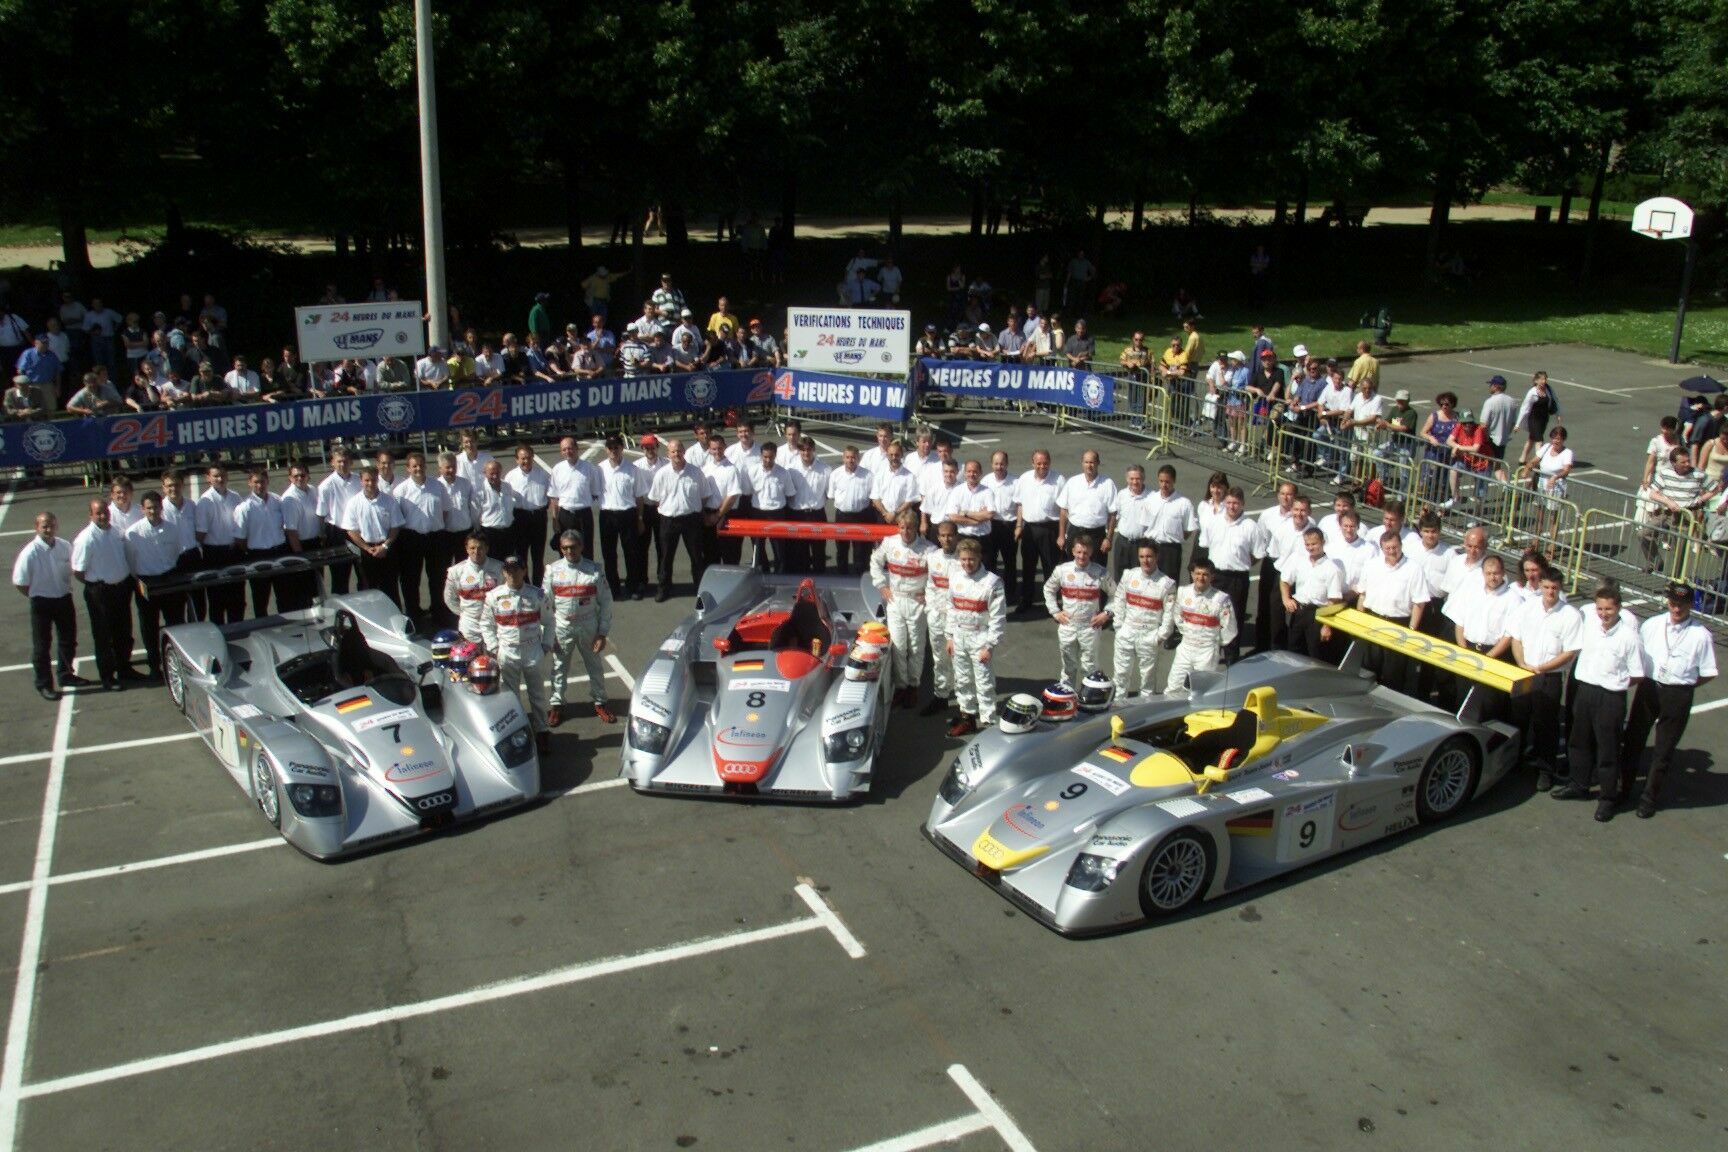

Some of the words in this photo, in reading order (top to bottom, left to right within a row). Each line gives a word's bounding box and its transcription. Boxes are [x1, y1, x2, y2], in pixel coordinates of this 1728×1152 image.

[331, 311, 350, 322] 24
[352, 312, 378, 321] HEURES
[381, 311, 392, 320] DU
[394, 310, 416, 319] MANS
[794, 314, 851, 328] VERIFICATIONS
[858, 316, 905, 330] TECHNIQUES
[817, 333, 835, 346] 24
[836, 336, 857, 347] HEURES
[858, 338, 868, 347] DU
[869, 338, 887, 348] MANS
[746, 371, 795, 403] 24
[798, 381, 855, 405] HEURES
[859, 385, 882, 406] DU
[928, 368, 993, 388] HEURES
[998, 369, 1023, 389] DU
[1028, 370, 1075, 391] MANS
[449, 388, 507, 426] 24
[511, 388, 581, 417] HEURES
[588, 385, 614, 407] DU
[620, 378, 672, 403] MANS
[107, 415, 174, 455] 24
[178, 413, 258, 444] HEURES
[266, 408, 296, 433] DU
[303, 400, 362, 428] MANS
[745, 691, 766, 708] 8
[381, 723, 401, 744] 7
[1060, 782, 1088, 800] 9
[1299, 820, 1316, 848] 9
